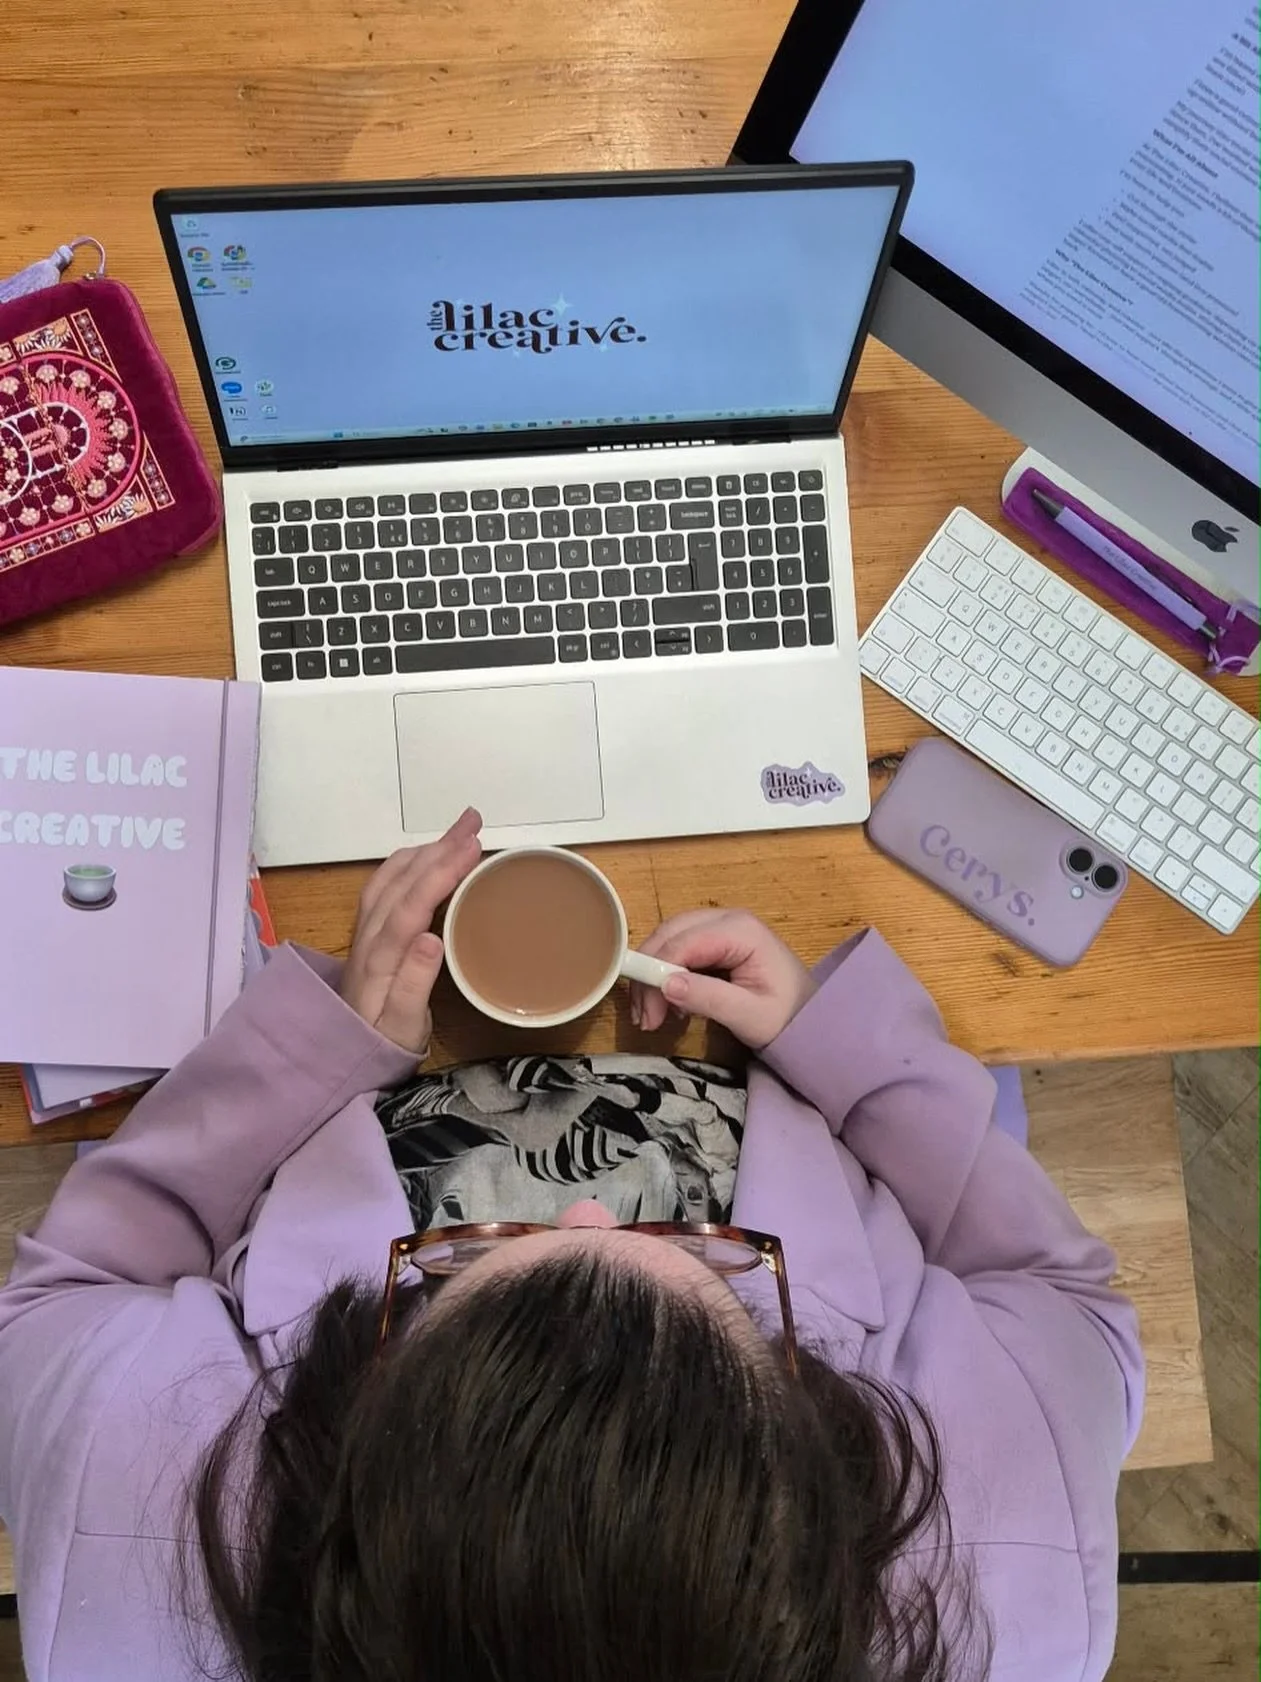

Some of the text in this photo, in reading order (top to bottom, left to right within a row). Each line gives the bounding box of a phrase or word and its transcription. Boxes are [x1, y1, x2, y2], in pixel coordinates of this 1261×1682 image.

[426, 310, 443, 331] the
[432, 300, 554, 331] lilac
[434, 317, 647, 354] creative.
[0, 747, 188, 787] THE LILAC
[766, 770, 808, 788] lilac
[769, 777, 841, 799] creative.
[0, 810, 186, 850] CREATIVE
[920, 825, 1035, 926] Cerys.
